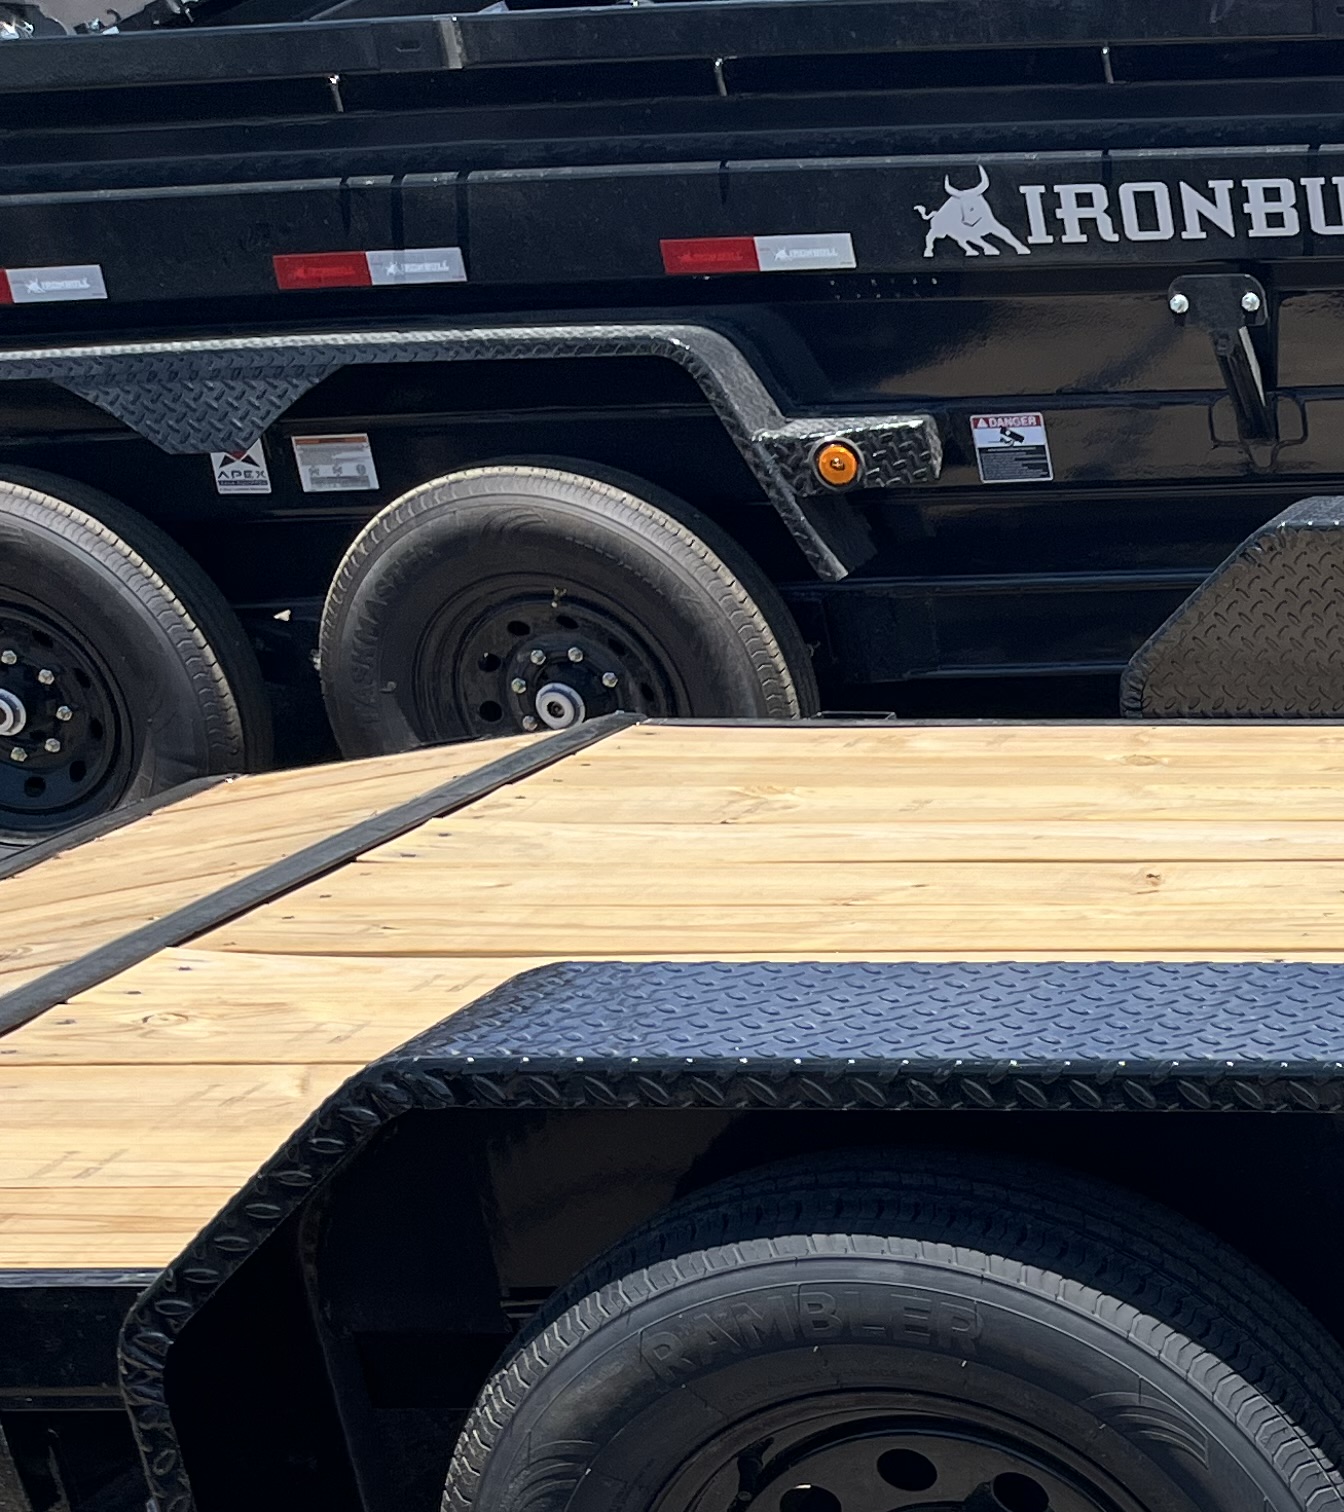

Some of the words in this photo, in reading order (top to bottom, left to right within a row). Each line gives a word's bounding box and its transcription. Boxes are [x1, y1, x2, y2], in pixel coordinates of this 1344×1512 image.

[988, 415, 1037, 429] DANGER
[217, 469, 268, 480] APEX
[641, 1291, 985, 1384] RAMBLER
